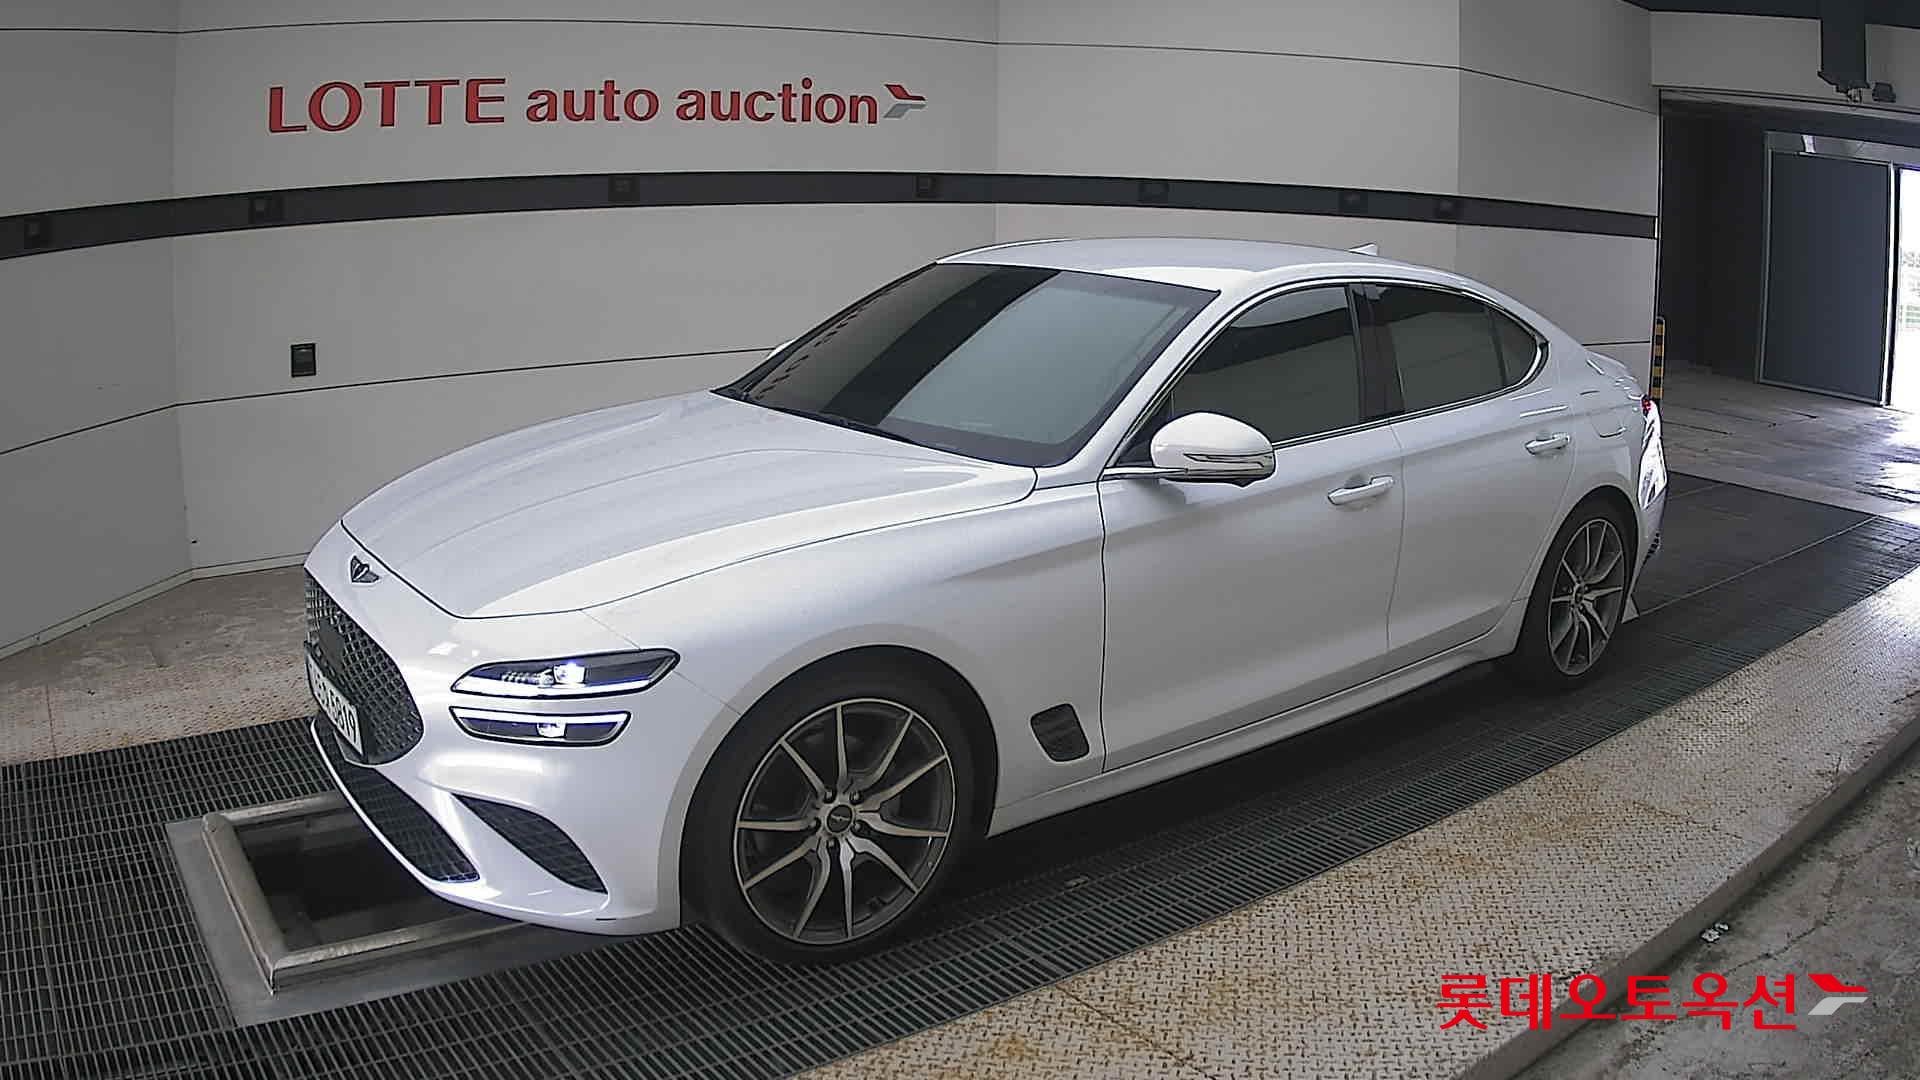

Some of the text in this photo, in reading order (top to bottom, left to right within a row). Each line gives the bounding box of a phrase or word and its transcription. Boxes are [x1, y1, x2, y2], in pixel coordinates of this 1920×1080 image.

[269, 77, 878, 133] LOTTE auto auction
